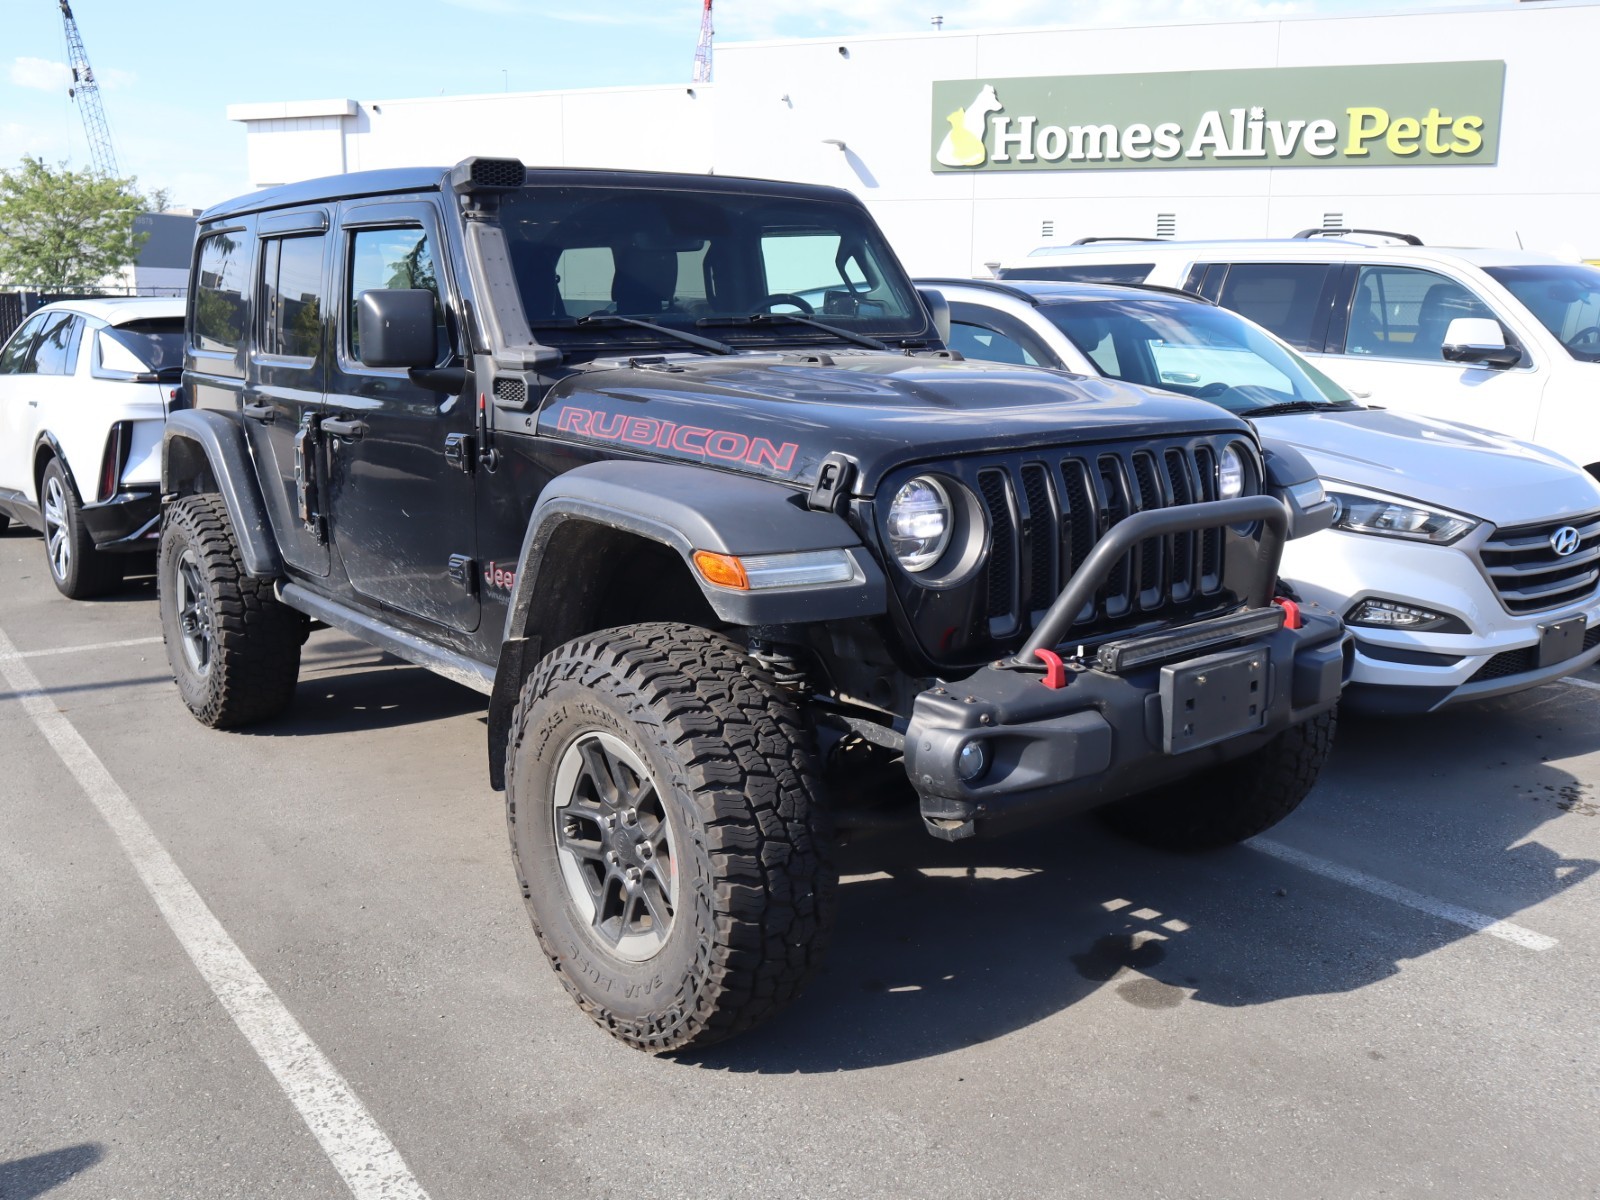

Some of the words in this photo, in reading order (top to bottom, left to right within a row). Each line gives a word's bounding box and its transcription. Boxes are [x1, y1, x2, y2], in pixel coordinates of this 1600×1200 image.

[991, 115, 1181, 161] Homes
[1185, 106, 1337, 158] Alive
[1343, 107, 1483, 155] Pets
[557, 406, 799, 471] RUBICON
